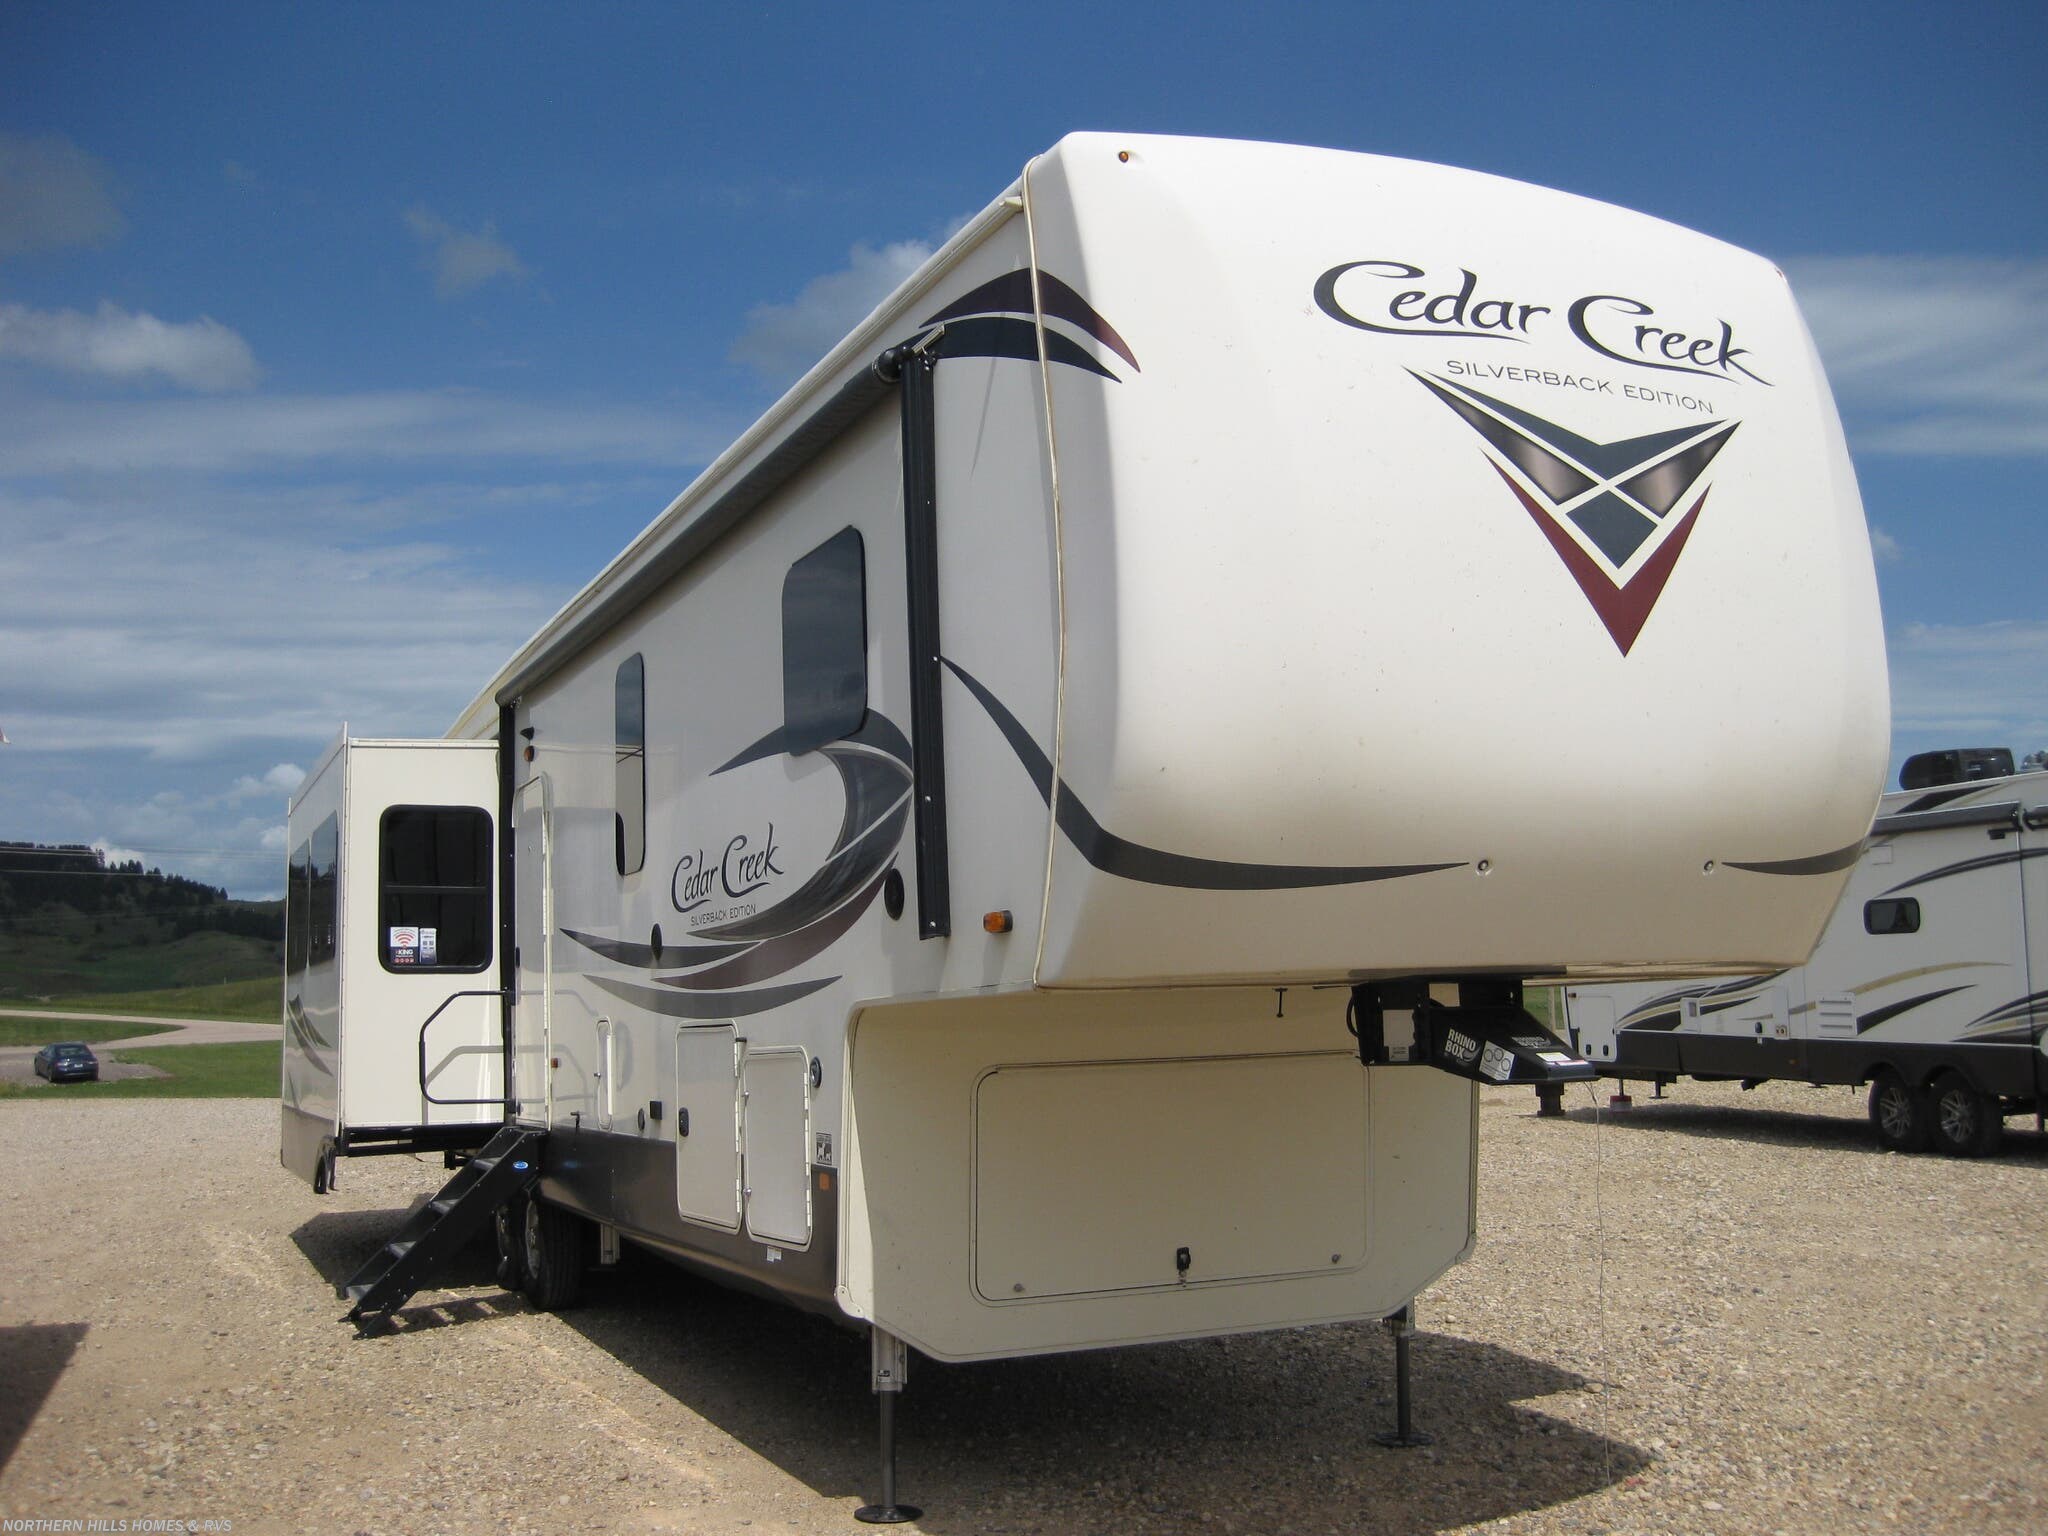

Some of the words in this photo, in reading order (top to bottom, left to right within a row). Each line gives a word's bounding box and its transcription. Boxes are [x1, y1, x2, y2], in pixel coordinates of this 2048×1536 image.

[1313, 260, 1551, 344] Cedar
[1567, 294, 1776, 387] Creek
[1446, 359, 1614, 394] SILVERBACK
[1624, 384, 1715, 415] EDITION
[671, 849, 719, 913] Cedar
[721, 822, 785, 898] Creek
[690, 909, 728, 927] SILVERBACK
[729, 903, 757, 919] EDITION
[1444, 1040, 1465, 1060] BOX
[1447, 1028, 1477, 1052] RHINO
